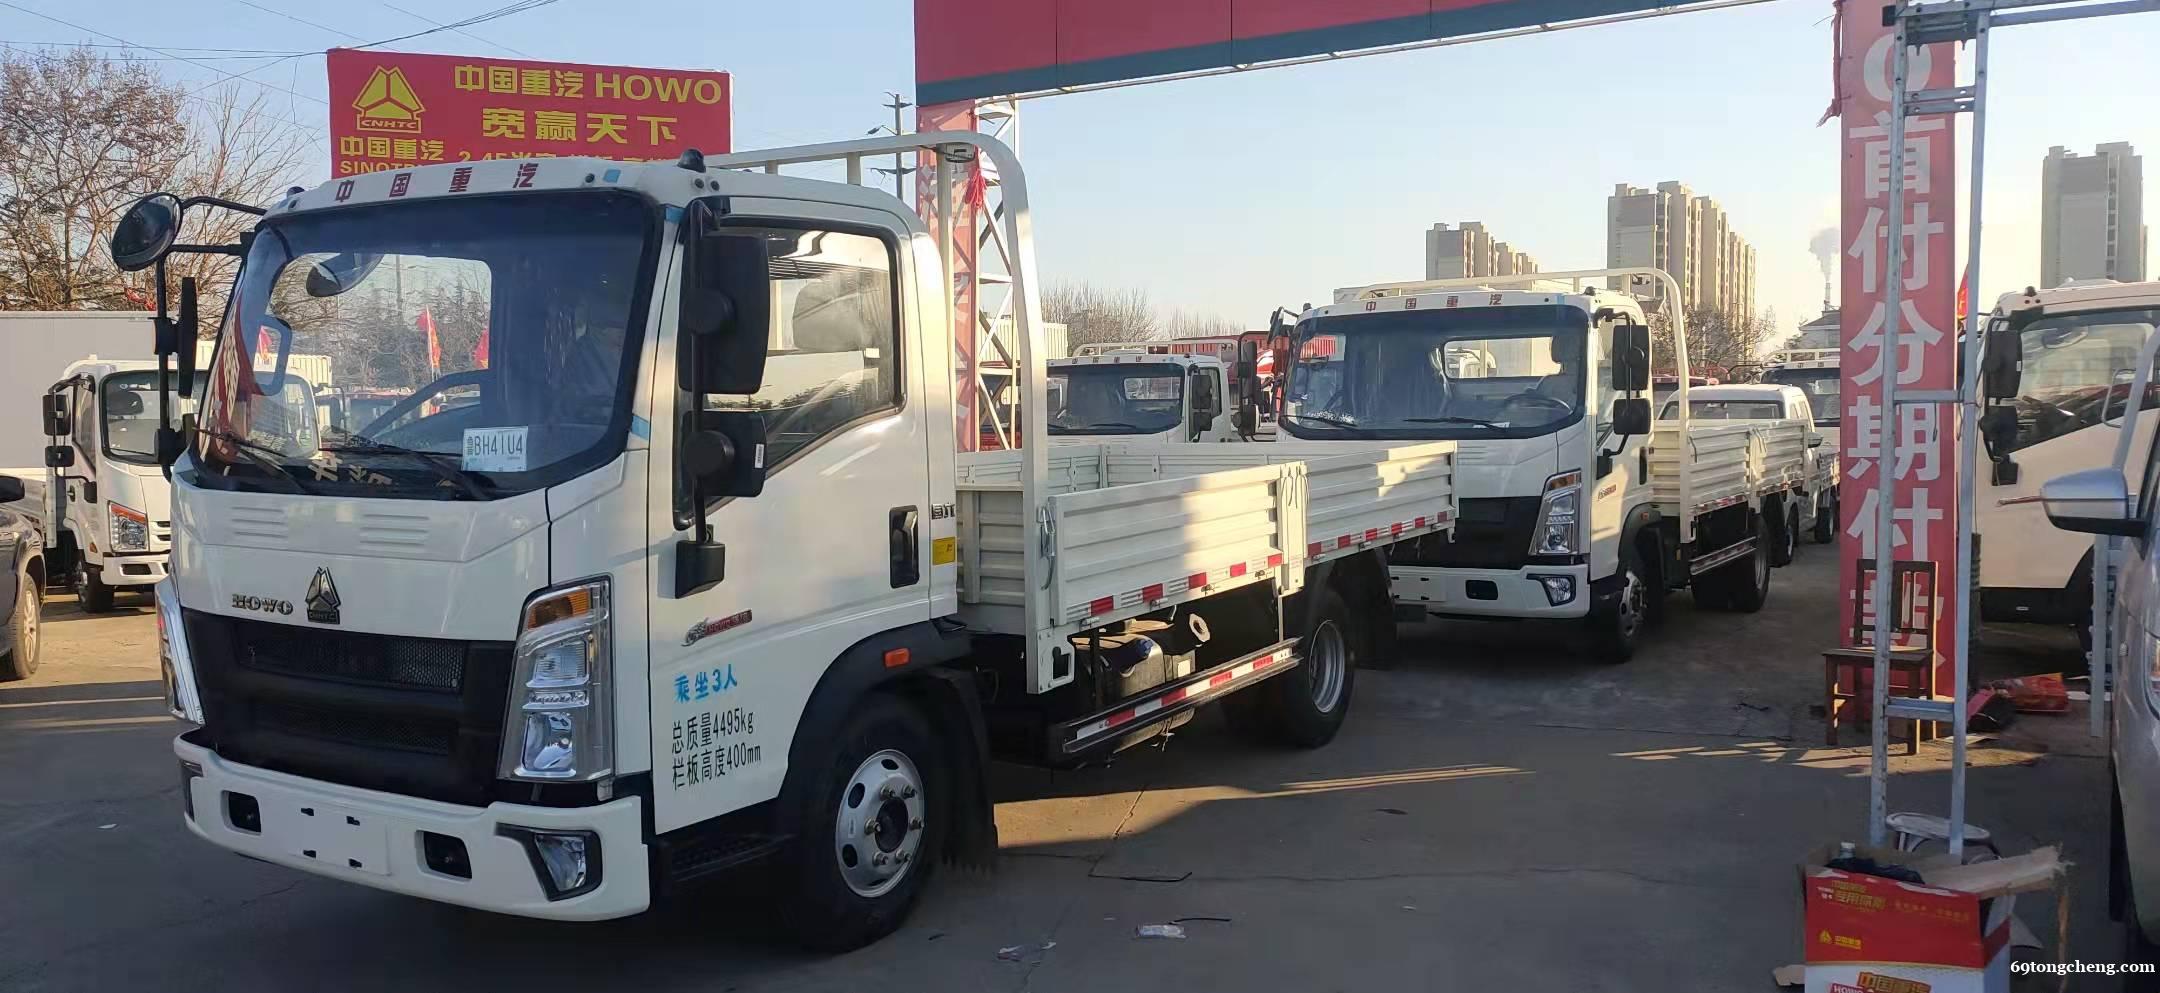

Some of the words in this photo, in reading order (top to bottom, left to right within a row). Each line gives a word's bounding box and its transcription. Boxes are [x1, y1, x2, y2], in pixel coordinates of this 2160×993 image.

[454, 64, 584, 98] 中国重汽
[596, 72, 721, 104] HOWO
[361, 119, 418, 129] CNHTC
[482, 107, 678, 145] 宽赢天下
[340, 136, 444, 161] 中国重汽
[335, 163, 539, 203] 中国重汽
[1365, 293, 1503, 312] 中国重汽
[231, 593, 294, 616] HOWO
[674, 663, 738, 703] 乘坐3人
[672, 707, 754, 754] 总质量4495kg
[672, 742, 761, 791] 栏板高度400mm
